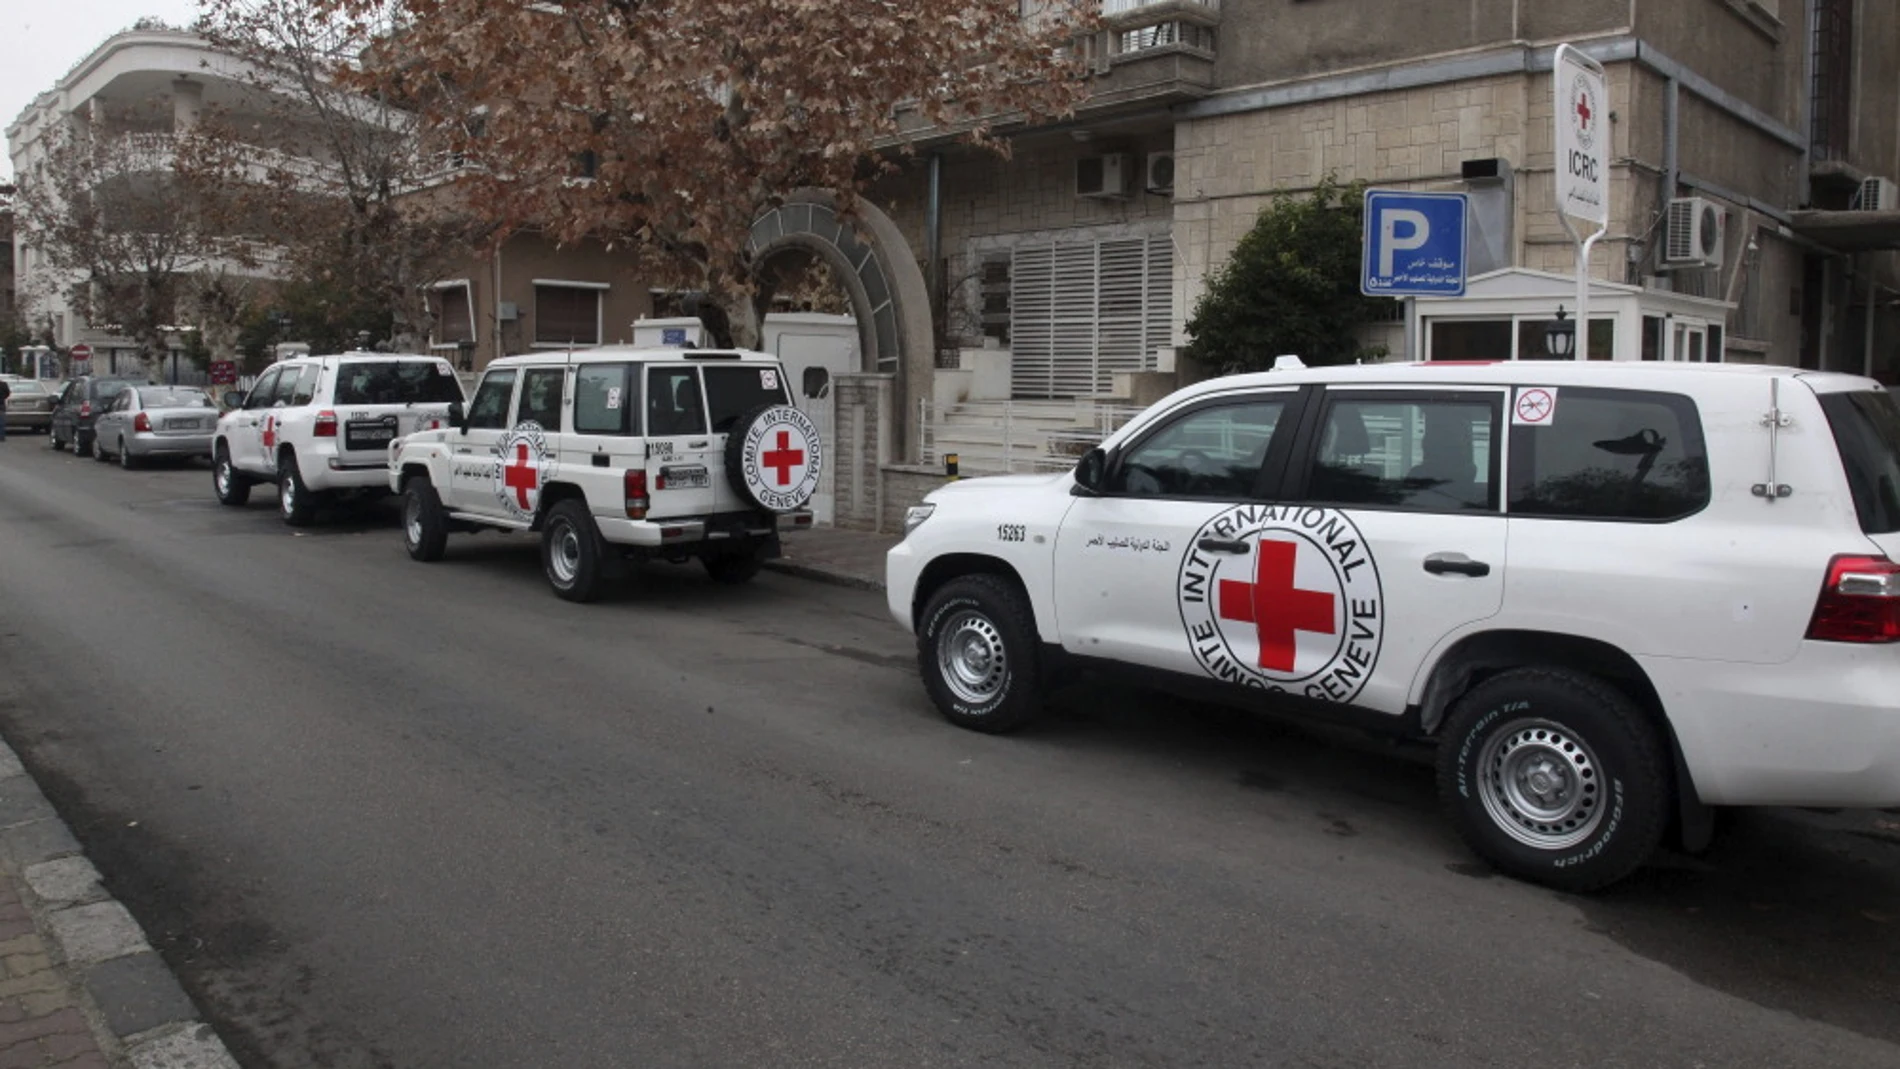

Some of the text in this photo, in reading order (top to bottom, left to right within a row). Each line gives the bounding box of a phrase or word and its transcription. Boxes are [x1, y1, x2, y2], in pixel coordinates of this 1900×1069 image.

[1568, 148, 1599, 183] ICRC
[1379, 208, 1430, 277] P
[1428, 257, 1455, 271] موقف
[744, 409, 820, 486] COMITE INTERNATIONAL
[759, 488, 808, 508] GENEVE
[997, 524, 1026, 542] 15263
[1183, 505, 1366, 602] INTRNATIONAL
[1554, 777, 1624, 868] BFGoodrich
